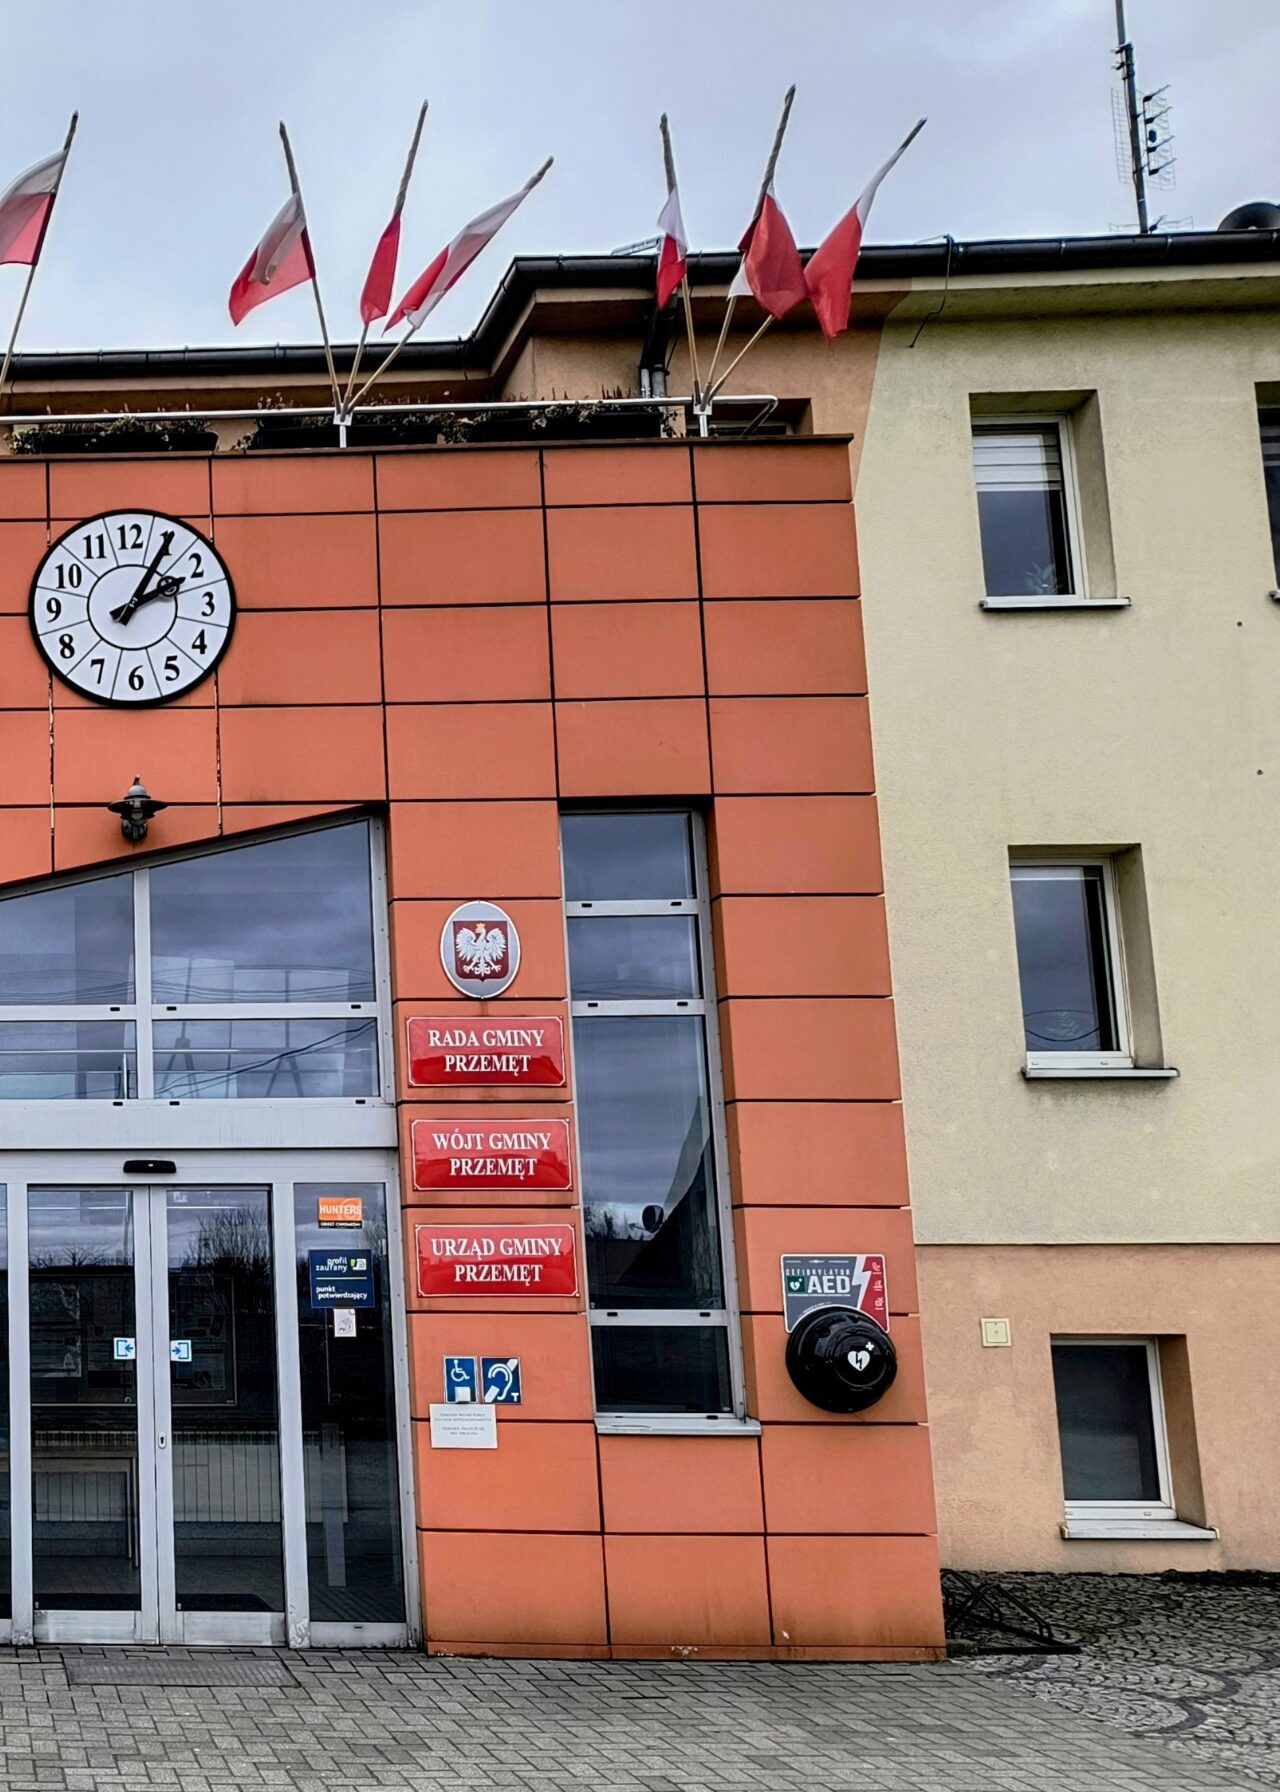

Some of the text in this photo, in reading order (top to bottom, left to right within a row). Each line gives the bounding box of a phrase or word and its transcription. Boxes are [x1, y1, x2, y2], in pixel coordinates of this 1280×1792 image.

[83, 533, 107, 559] 11
[117, 523, 144, 550] 12
[55, 563, 82, 589] 10
[188, 553, 205, 579] 2
[46, 598, 62, 623] 9
[201, 591, 216, 617] 3
[58, 634, 76, 659] 8
[191, 629, 208, 655] 4
[90, 658, 106, 685] 7
[128, 665, 145, 691] 6
[163, 655, 181, 682] 5
[428, 1029, 545, 1047] RADA GMINY
[444, 1054, 532, 1076] PRZEMĘT
[432, 1128, 551, 1150] WÓJT GMINY
[449, 1158, 538, 1180] PRZEMĘT
[319, 1204, 362, 1215] HUNTERS
[431, 1238, 563, 1261] URZĄD GMINY
[315, 1264, 348, 1273] zaufany
[327, 1257, 348, 1265] profil
[454, 1264, 543, 1286] PRZEMĘT
[807, 1275, 851, 1294] AED
[316, 1285, 336, 1293] punkt
[318, 1292, 368, 1300] potwierdzający
[511, 1392, 519, 1402] T
